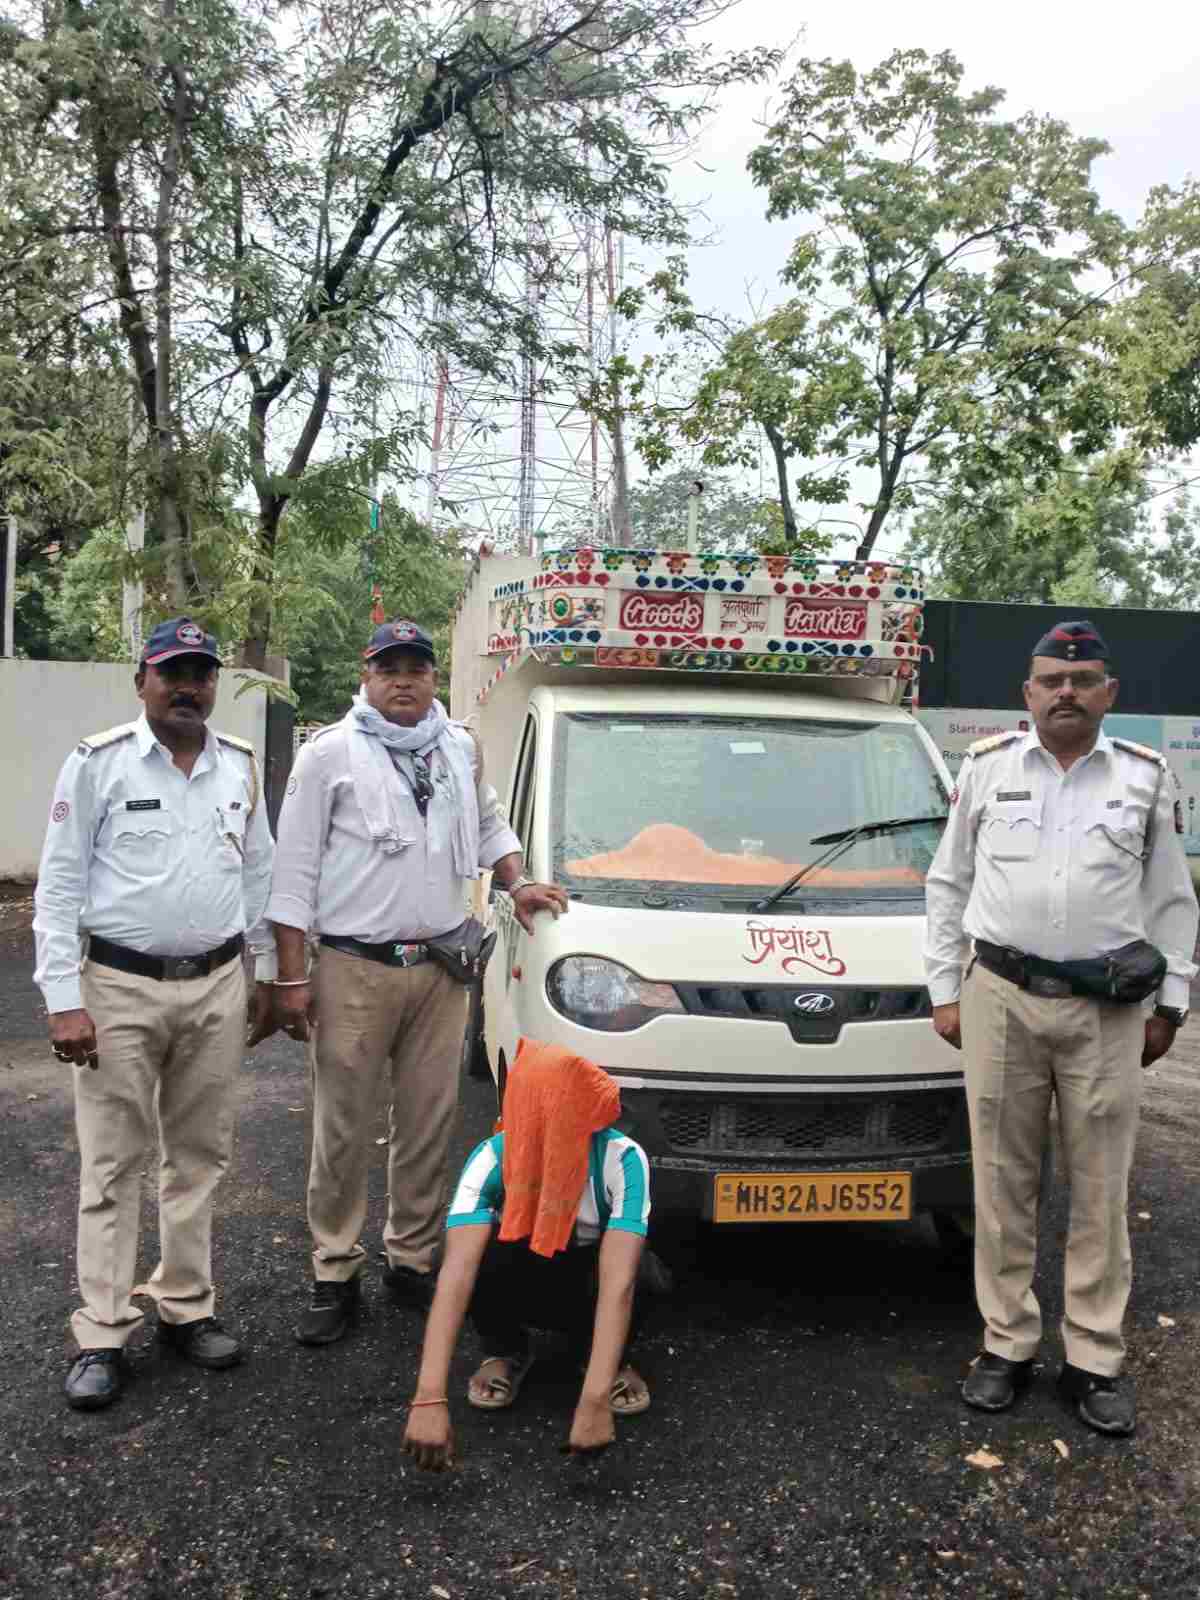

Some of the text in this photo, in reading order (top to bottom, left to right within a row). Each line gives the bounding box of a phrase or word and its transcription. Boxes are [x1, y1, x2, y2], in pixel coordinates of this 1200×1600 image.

[624, 595, 702, 629] Goods
[784, 602, 866, 634] Carrier
[949, 723, 976, 734] Start
[736, 1182, 904, 1214] MH32AJ6552
